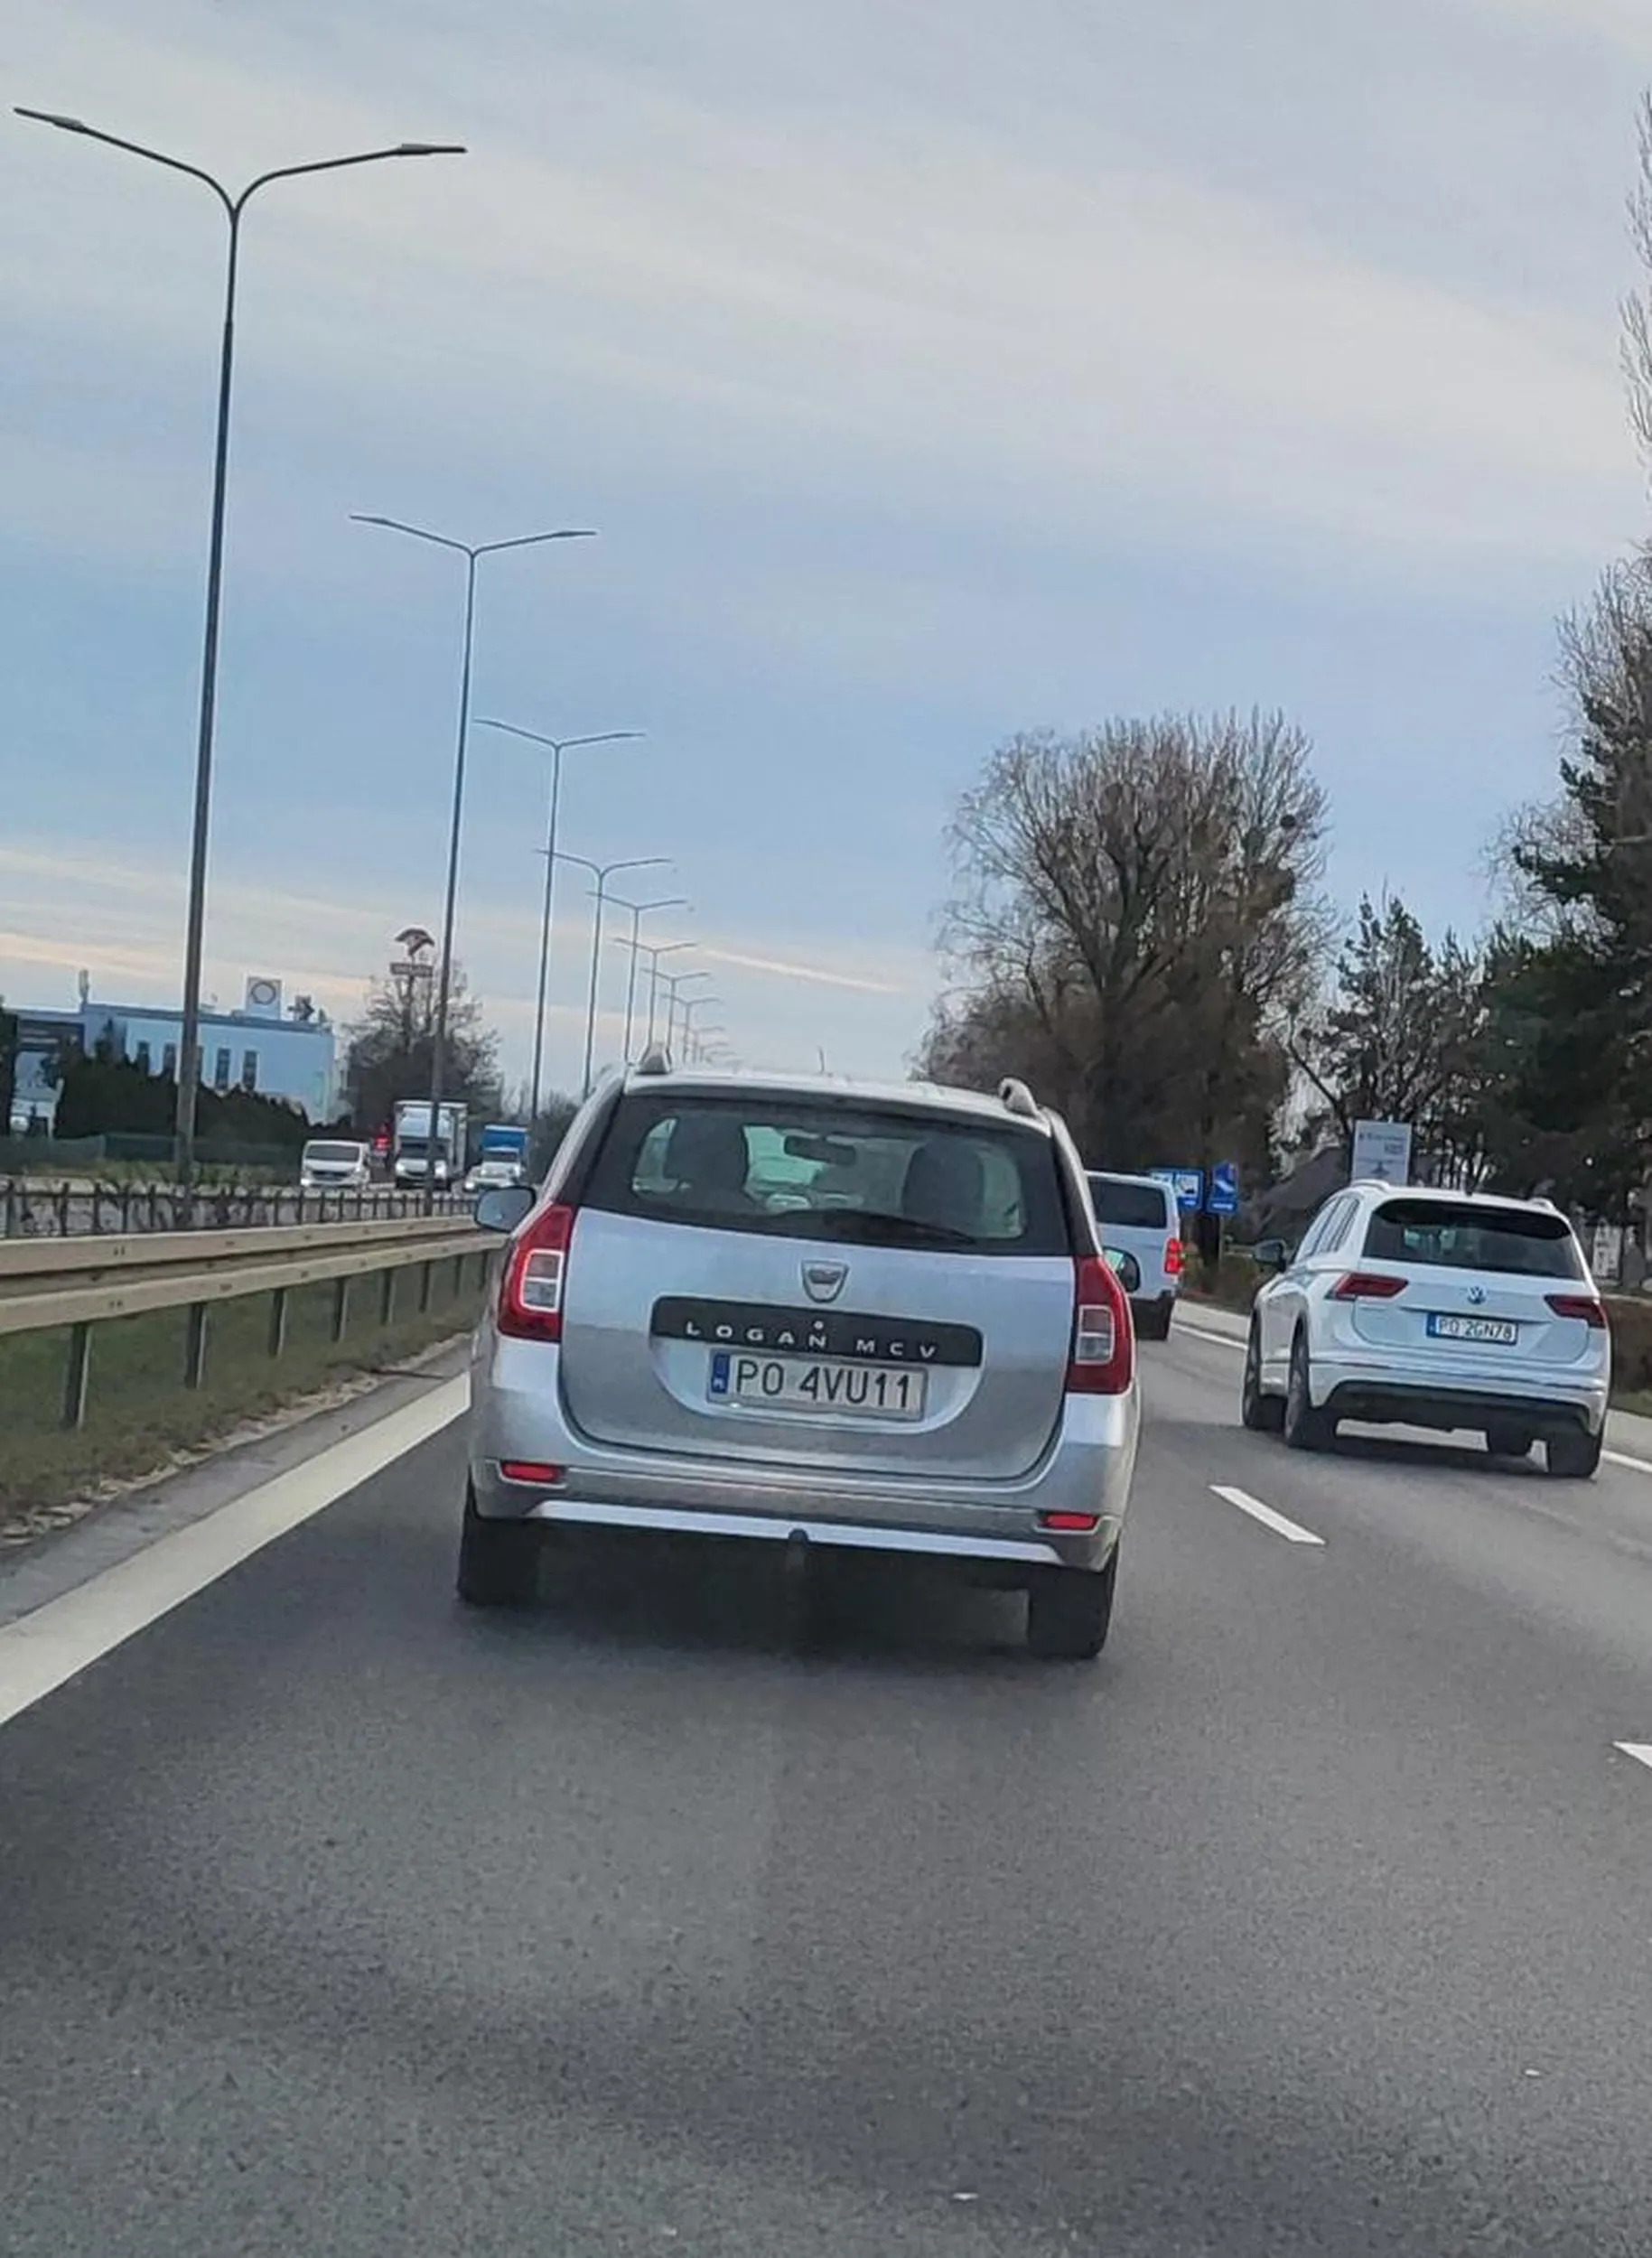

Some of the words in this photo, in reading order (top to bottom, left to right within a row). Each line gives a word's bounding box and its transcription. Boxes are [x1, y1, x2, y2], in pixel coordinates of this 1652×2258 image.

[686, 1321, 826, 1348] LOGAN
[856, 1339, 936, 1358] MCV
[735, 1359, 784, 1395] PO
[799, 1366, 910, 1408] 4VU11
